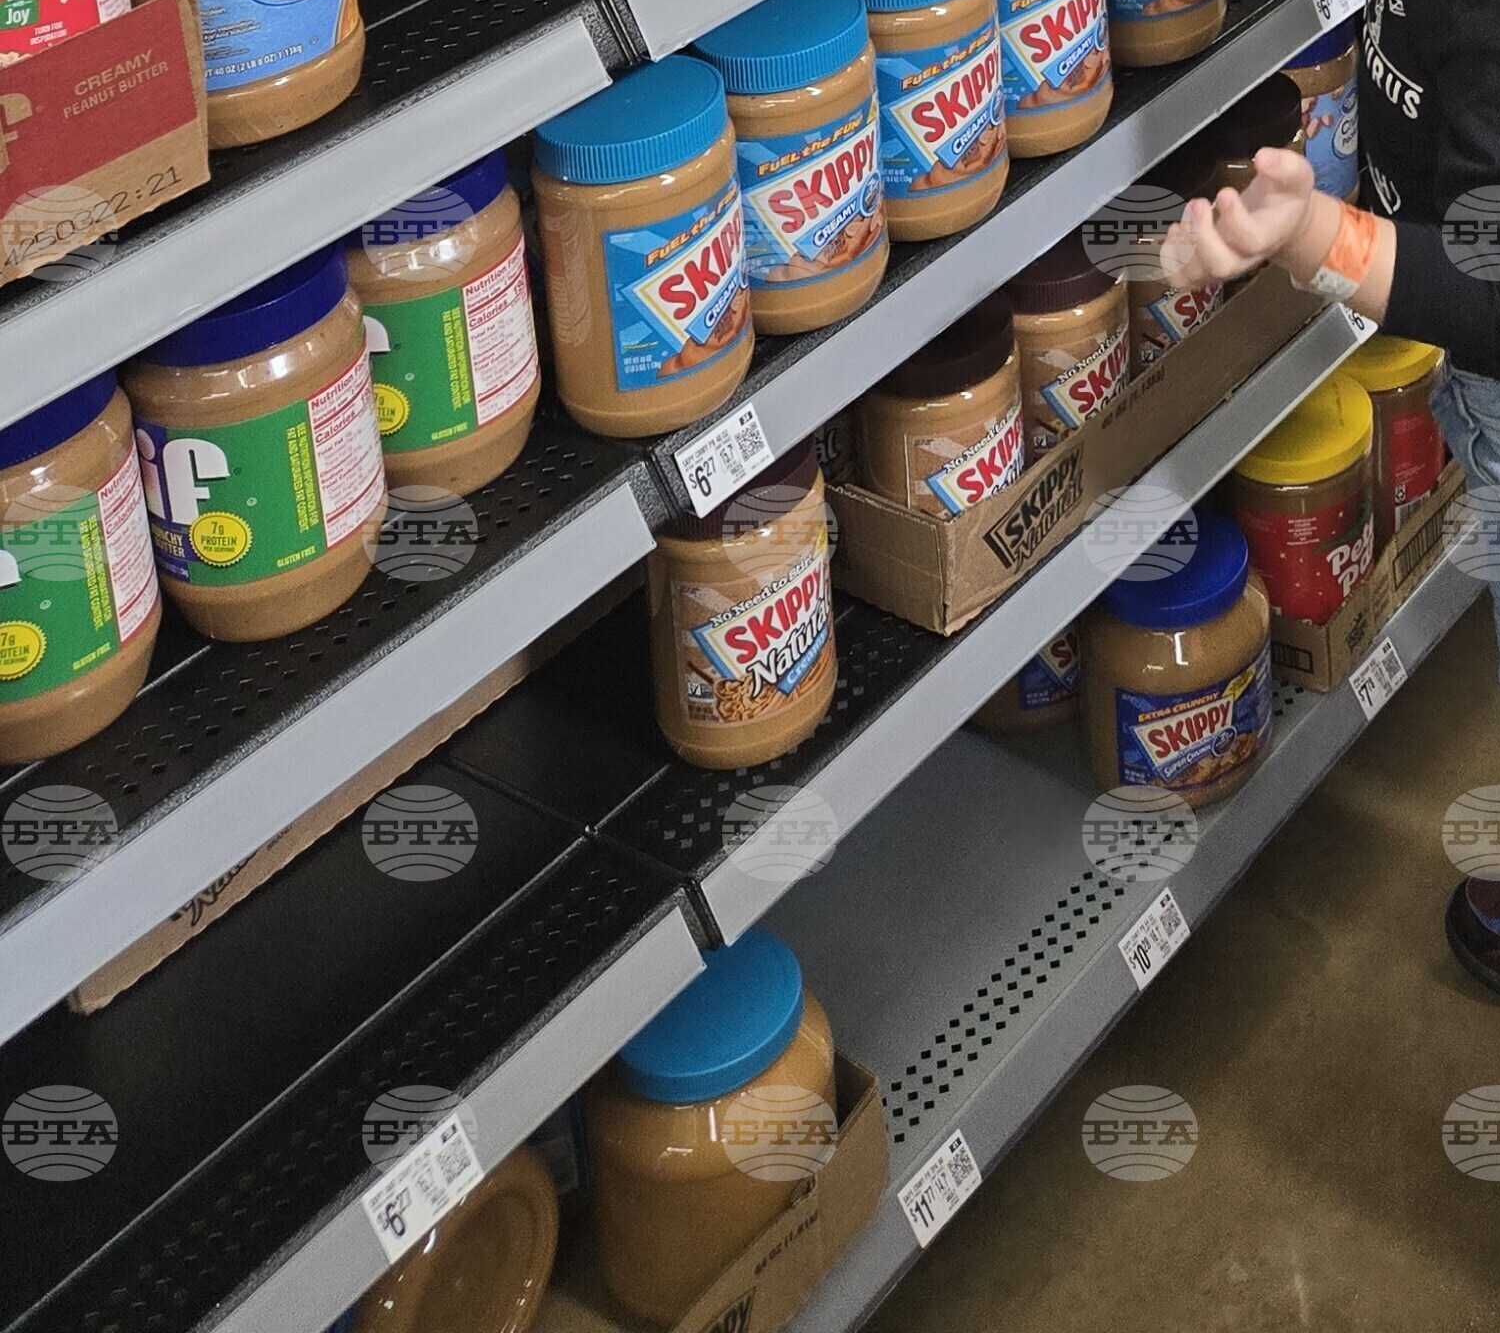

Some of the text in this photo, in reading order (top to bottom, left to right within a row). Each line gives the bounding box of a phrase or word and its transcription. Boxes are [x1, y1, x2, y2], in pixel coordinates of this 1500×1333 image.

[4, 6, 30, 26] Joy
[74, 49, 153, 97] CREAMY
[1057, 35, 1094, 77] CREAMY
[64, 61, 169, 119] PEANUT BUTTER
[911, 43, 999, 143] SKIPPY
[951, 111, 989, 156] CREAMY
[768, 131, 875, 234] SKIPPY
[812, 201, 858, 247] CREAMY
[1006, 445, 1083, 545] SKIPPY
[200, 534, 238, 548] PROTEIN
[711, 610, 733, 628] No
[732, 588, 770, 619] Need
[723, 565, 824, 664] SKIPPY
[1147, 695, 1235, 761] SKIPPY
